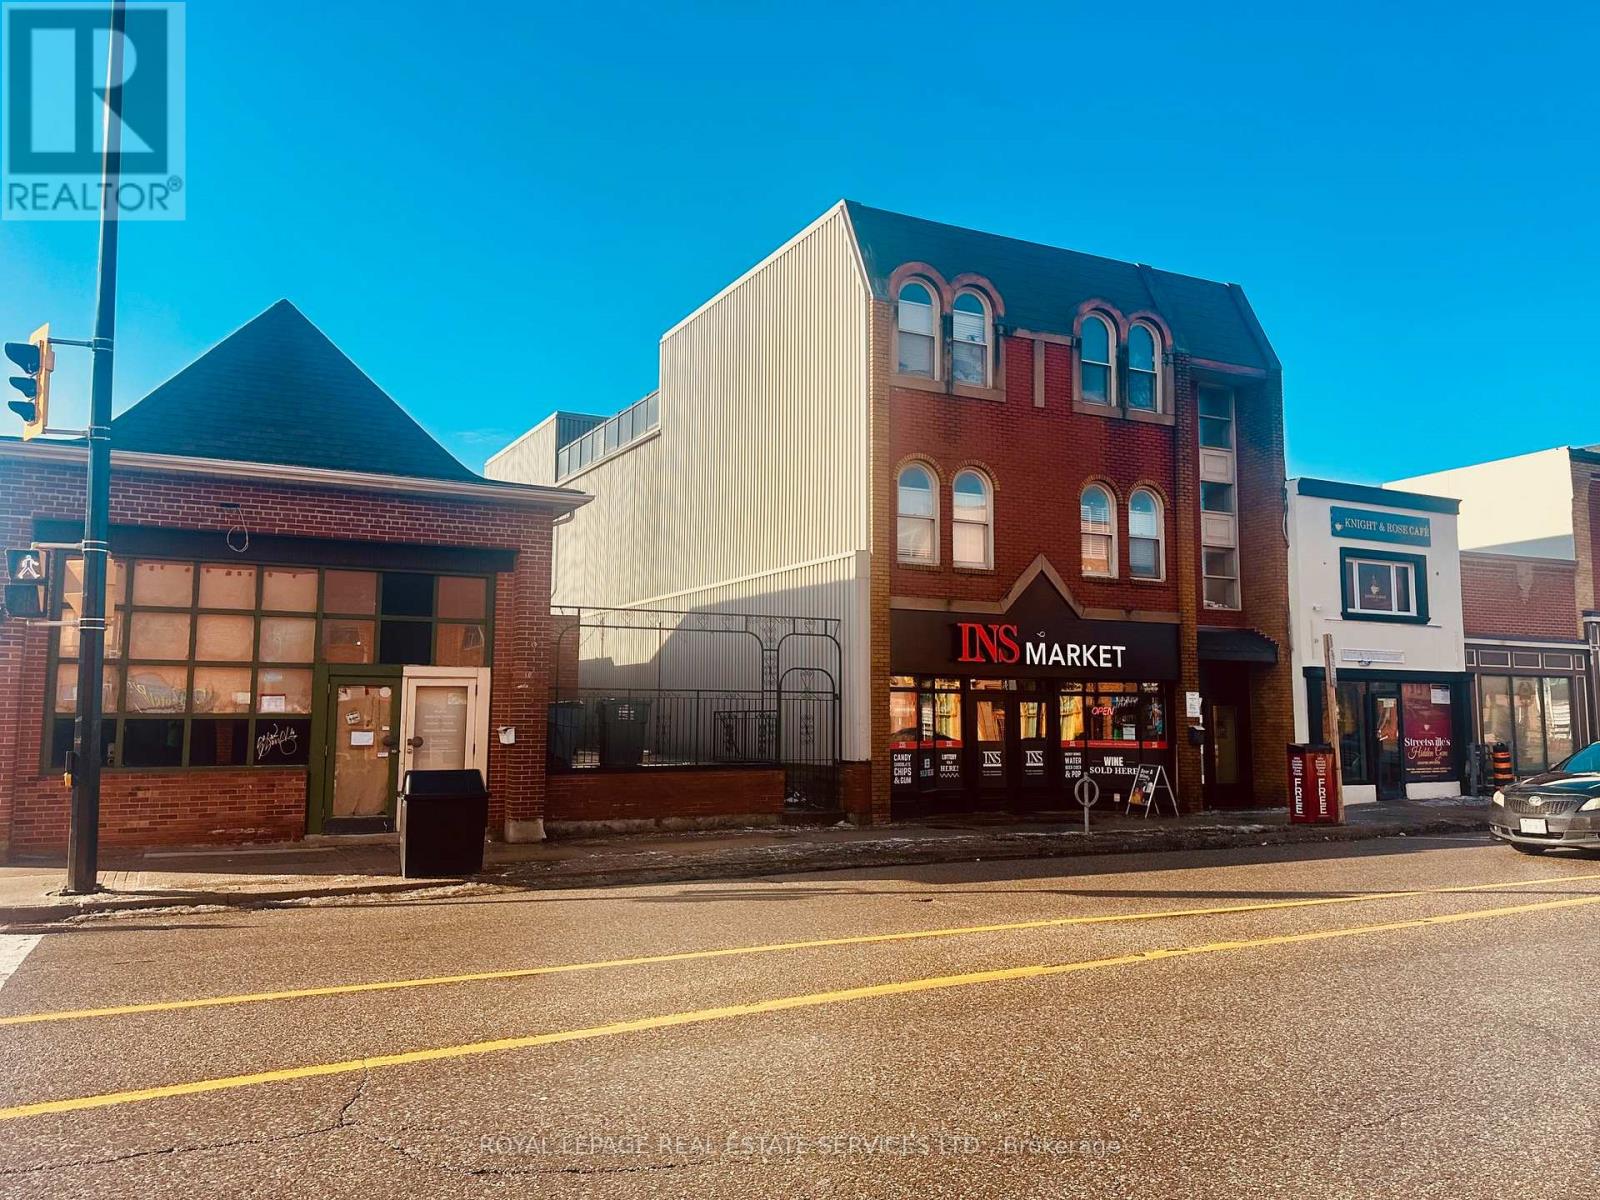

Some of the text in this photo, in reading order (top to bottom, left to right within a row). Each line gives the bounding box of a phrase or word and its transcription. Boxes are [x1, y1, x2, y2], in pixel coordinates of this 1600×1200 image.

[1344, 518, 1430, 537] KNIGHT & ROSE CAFÉ
[957, 622, 1126, 668] INS MARKET
[1091, 706, 1115, 716] OPEN
[1404, 736, 1451, 747] Streetsville's
[893, 753, 912, 761] CANDY
[1103, 756, 1124, 767] WINE
[893, 767, 912, 776] CHIPS
[1072, 770, 1082, 778] POP
[1089, 766, 1112, 774] SOLD
[1114, 767, 1139, 775] HERE
[893, 776, 900, 784] &
[1294, 777, 1304, 814] FREE
[1318, 777, 1328, 814] FREE
